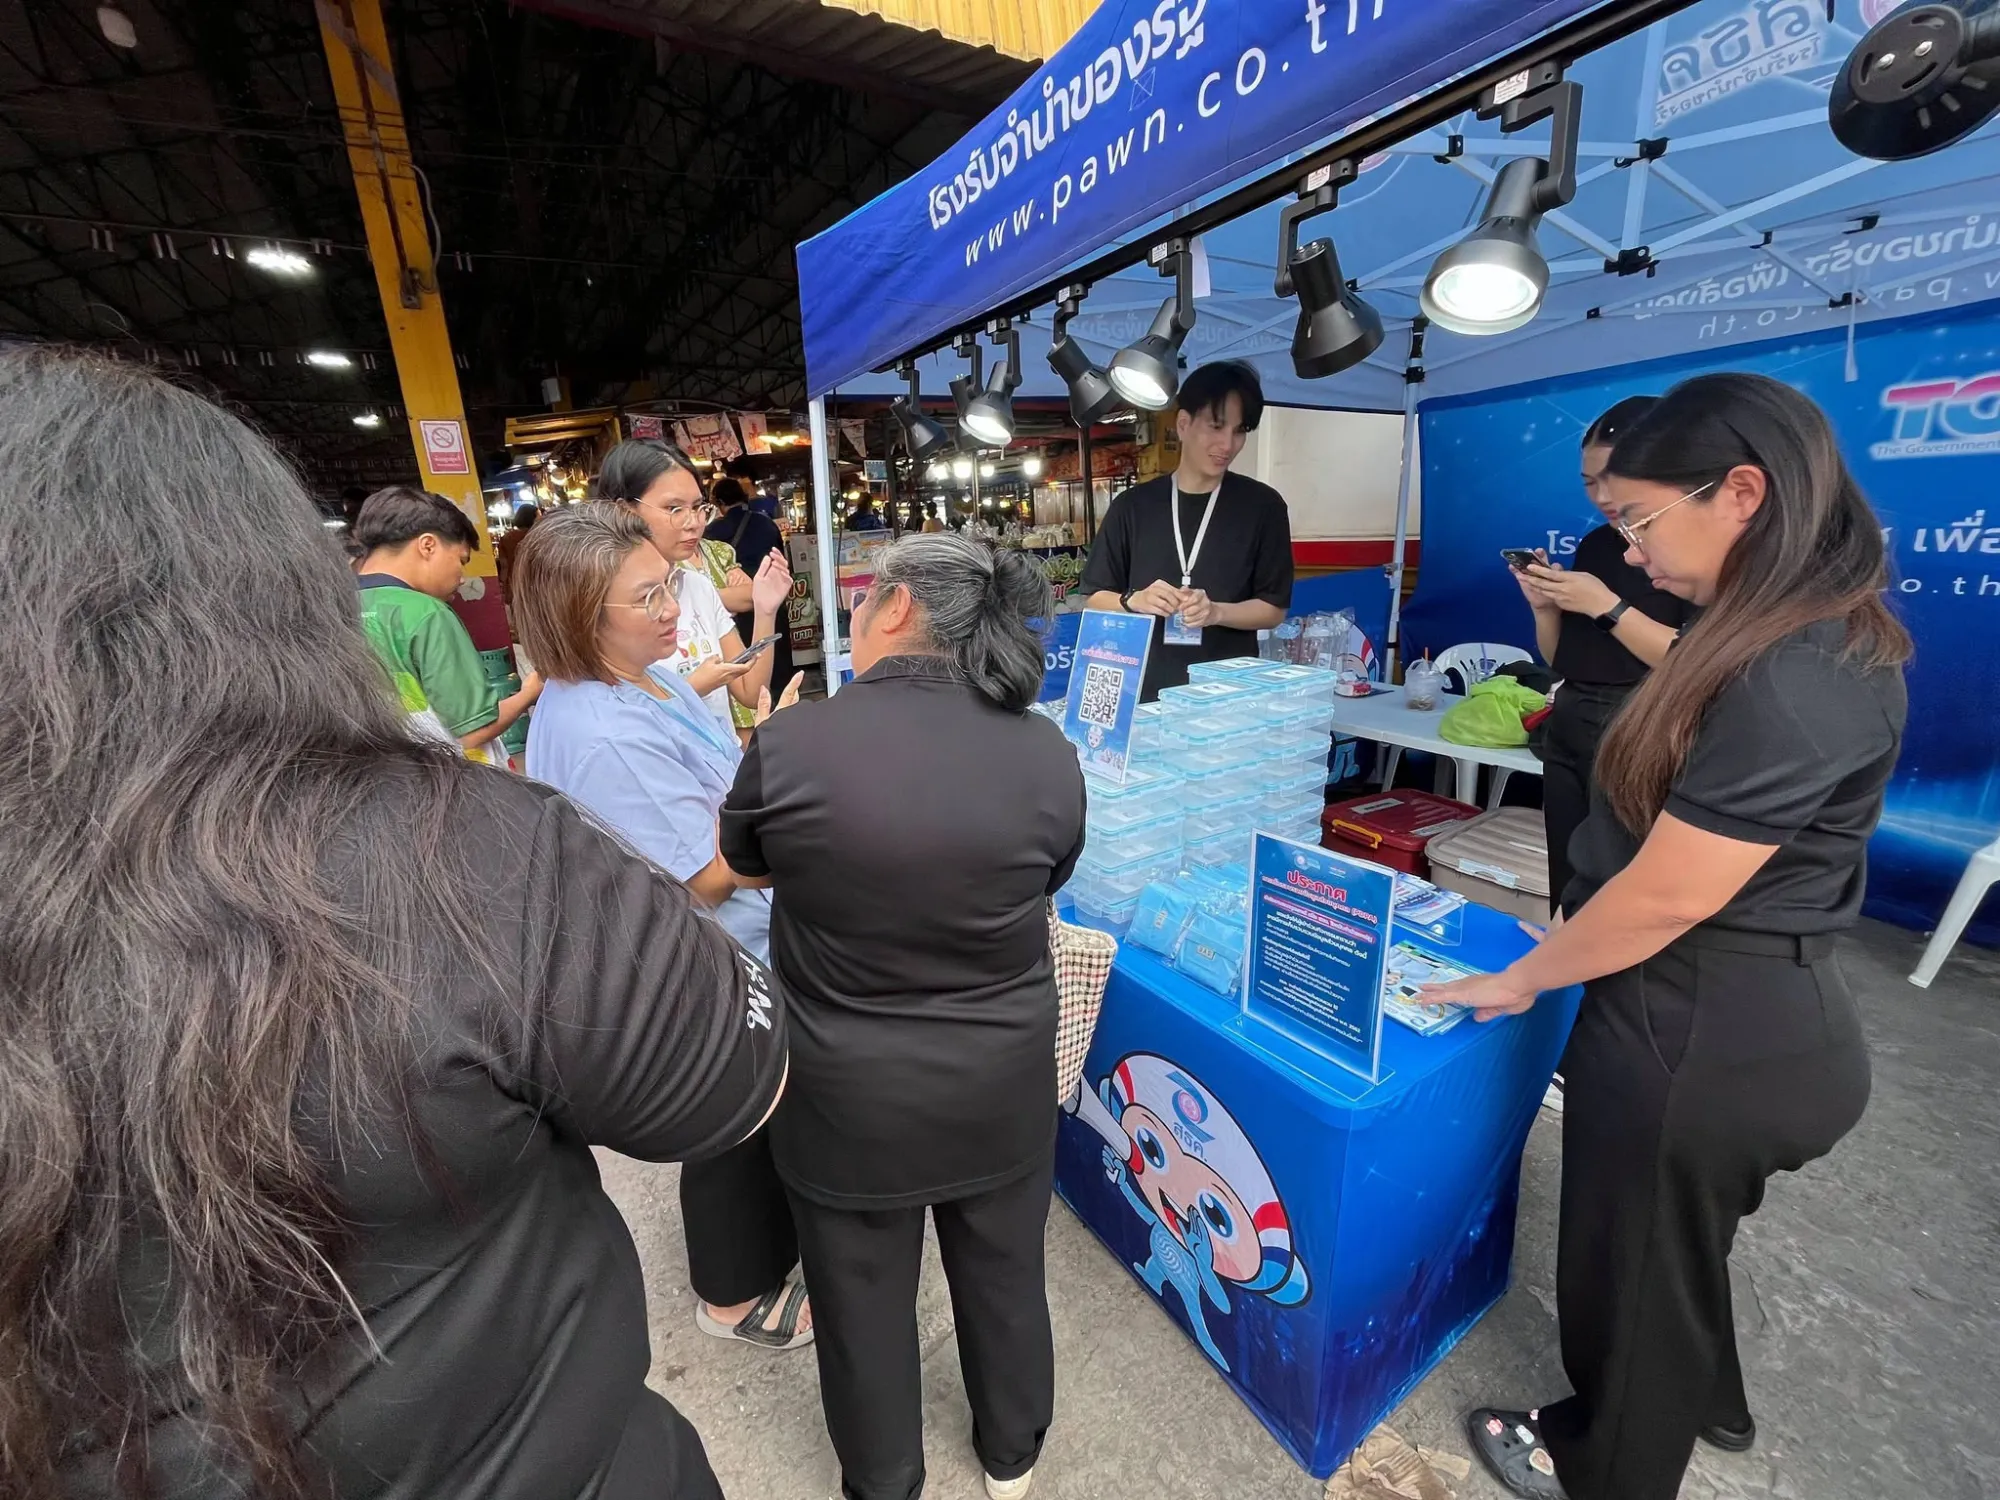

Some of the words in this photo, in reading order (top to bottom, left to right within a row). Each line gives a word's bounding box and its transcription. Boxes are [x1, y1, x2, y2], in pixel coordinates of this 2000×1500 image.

[929, 0, 1204, 230] โรงรับจำนำของรฐ
[1287, 870, 1348, 902] ประกาศ
